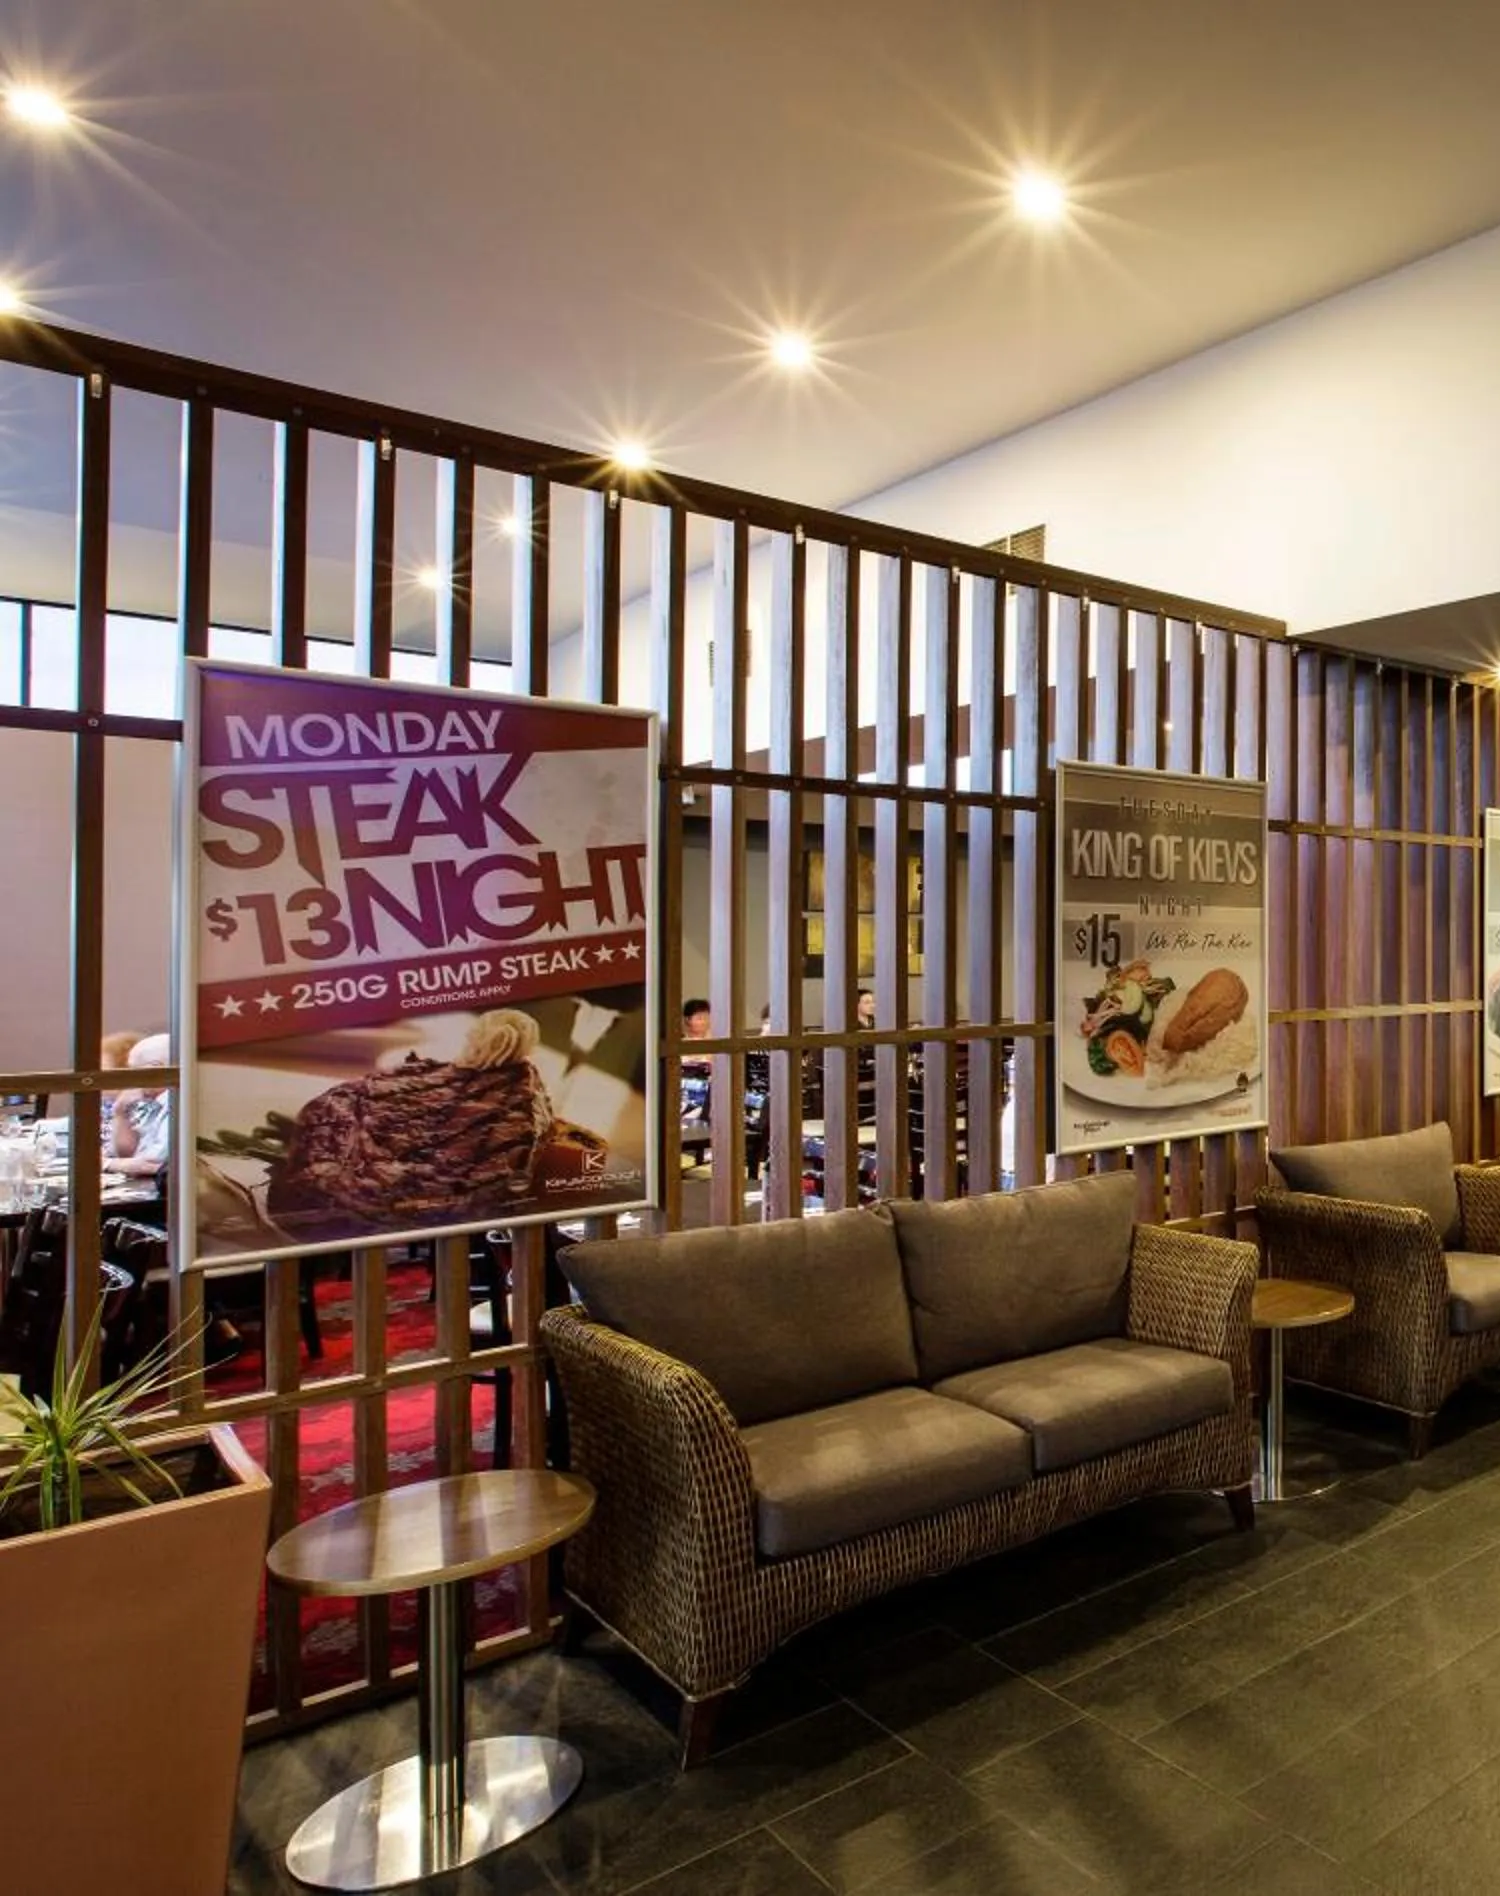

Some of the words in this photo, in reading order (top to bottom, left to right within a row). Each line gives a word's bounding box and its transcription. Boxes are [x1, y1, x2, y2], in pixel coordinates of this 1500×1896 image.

[225, 710, 503, 759] MONDAY
[198, 753, 543, 886] STEAK
[1119, 797, 1214, 825] TUESDAY
[1072, 829, 1143, 879] KING
[1150, 834, 1184, 881] OF
[1188, 836, 1257, 885] KIEVS
[206, 888, 352, 966] $13
[344, 844, 648, 957] NIGHT
[1139, 895, 1202, 916] NIGHT
[1075, 913, 1121, 968] $15
[291, 974, 389, 1010] 250G
[399, 960, 492, 994] RUMP
[501, 947, 591, 980] STEAK
[400, 990, 476, 1009] CONDITIONS
[479, 984, 512, 998] APPLY
